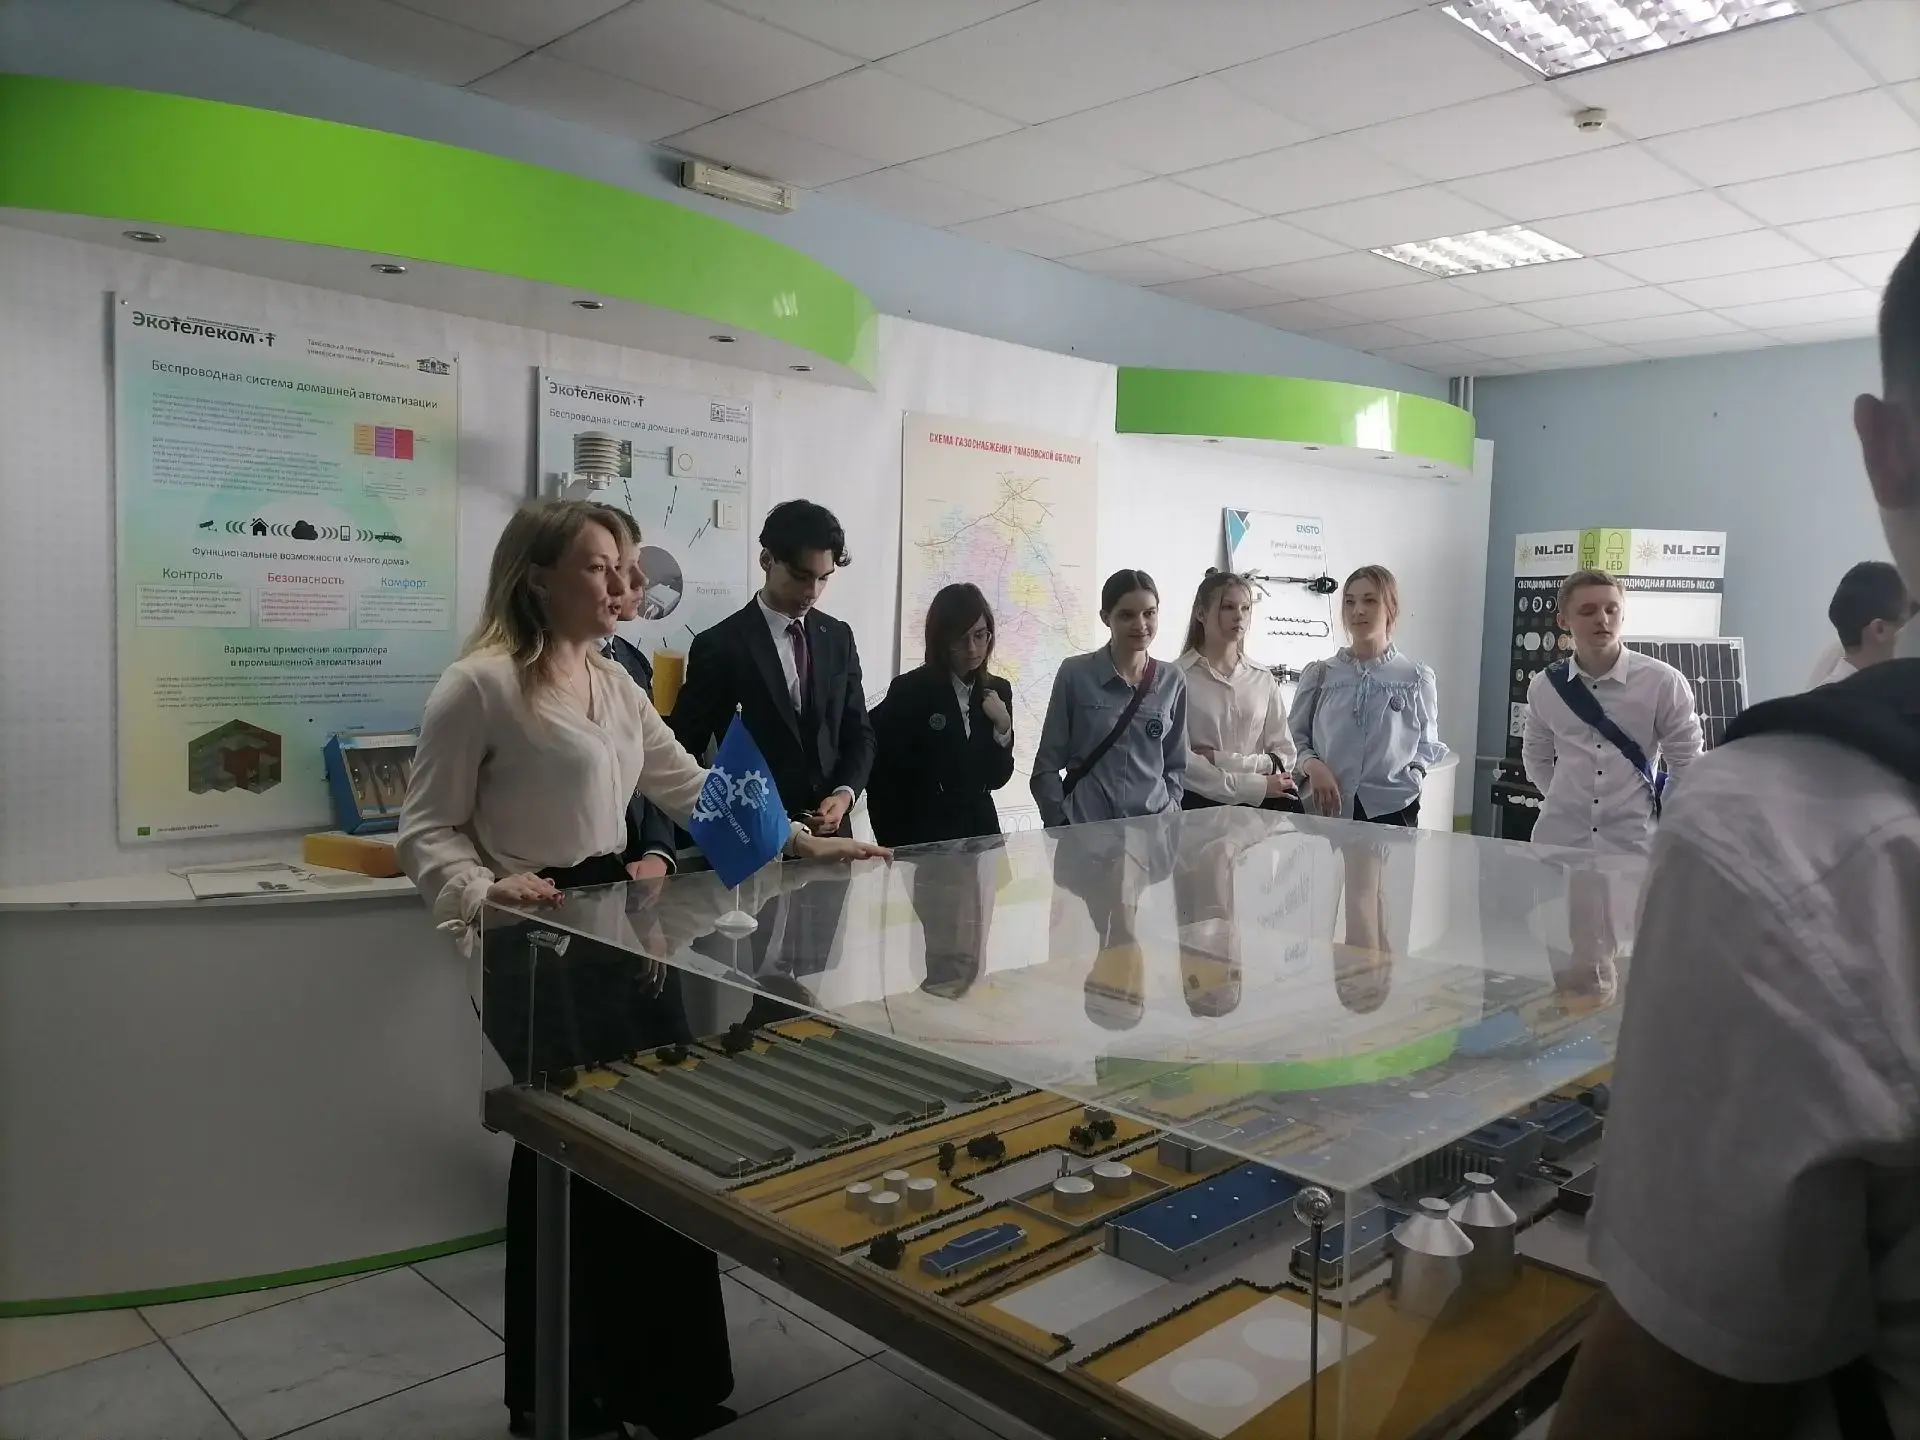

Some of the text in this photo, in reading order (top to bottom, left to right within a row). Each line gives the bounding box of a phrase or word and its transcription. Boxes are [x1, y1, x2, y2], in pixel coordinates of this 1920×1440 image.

[152, 360, 438, 410] Беспроводная система домашней автоматизации
[549, 408, 748, 443] Беспроводная система домашней автоматизации
[929, 432, 1082, 465] СХЕМА ГАЗОСНАБЖЕНИЯ ТАМБОВСКОЙ ОБЛАСТИ
[1296, 524, 1320, 535] ENSTO
[192, 546, 278, 560] Функциональные
[279, 552, 342, 563] возможности
[343, 555, 381, 565] «Умного
[1534, 543, 1574, 556] NLCO
[1662, 544, 1721, 556] NLCO
[1605, 560, 1623, 571] LED
[163, 568, 223, 583] Контроль
[267, 572, 345, 586] Безопасность
[381, 577, 428, 590] Комфорт
[1666, 579, 1696, 590] ПАНЕЛЬ
[1696, 580, 1716, 590] NLCO
[223, 645, 388, 656] Варианты применения контроллера
[238, 657, 314, 668] промышленной
[315, 658, 382, 668] автоматизации
